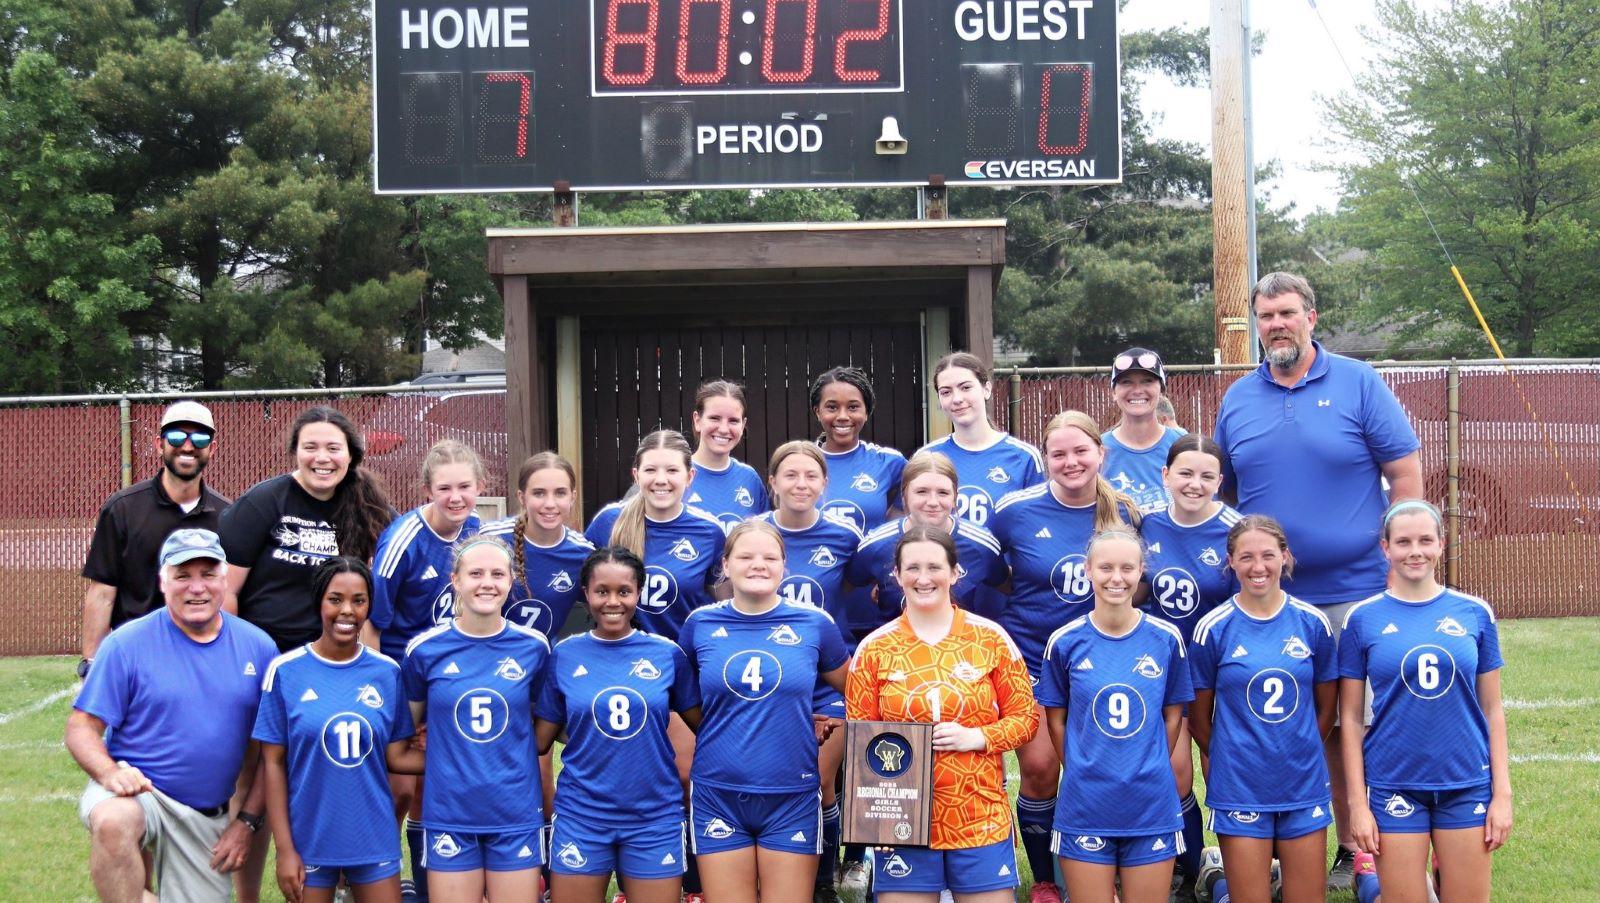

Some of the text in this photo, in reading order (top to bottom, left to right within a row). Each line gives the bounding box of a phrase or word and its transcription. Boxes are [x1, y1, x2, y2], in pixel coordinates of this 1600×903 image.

[401, 8, 530, 49] HOME
[954, 0, 1093, 41] GUEST
[603, 0, 889, 85] 80:02
[485, 72, 531, 158] 7
[1037, 64, 1092, 155] 0
[696, 124, 823, 154] PERIOD
[985, 159, 1096, 178] EVERSAN
[281, 515, 317, 527] SSUMPTION
[957, 494, 987, 526] 26
[272, 548, 308, 565] BACK
[641, 574, 669, 607] 12
[783, 583, 814, 607] 14
[1061, 562, 1090, 596] 18
[1158, 575, 1194, 611] 23
[437, 592, 456, 625] 2
[521, 606, 541, 628] 7
[741, 656, 763, 691] 4
[1417, 653, 1439, 690] 6
[608, 694, 630, 730] 8
[926, 688, 940, 722] 1
[1108, 692, 1129, 729] 9
[1263, 677, 1284, 714] 2
[471, 697, 492, 733] 5
[334, 721, 360, 759] 11
[857, 787, 918, 800] REGIONAL CHAMPION
